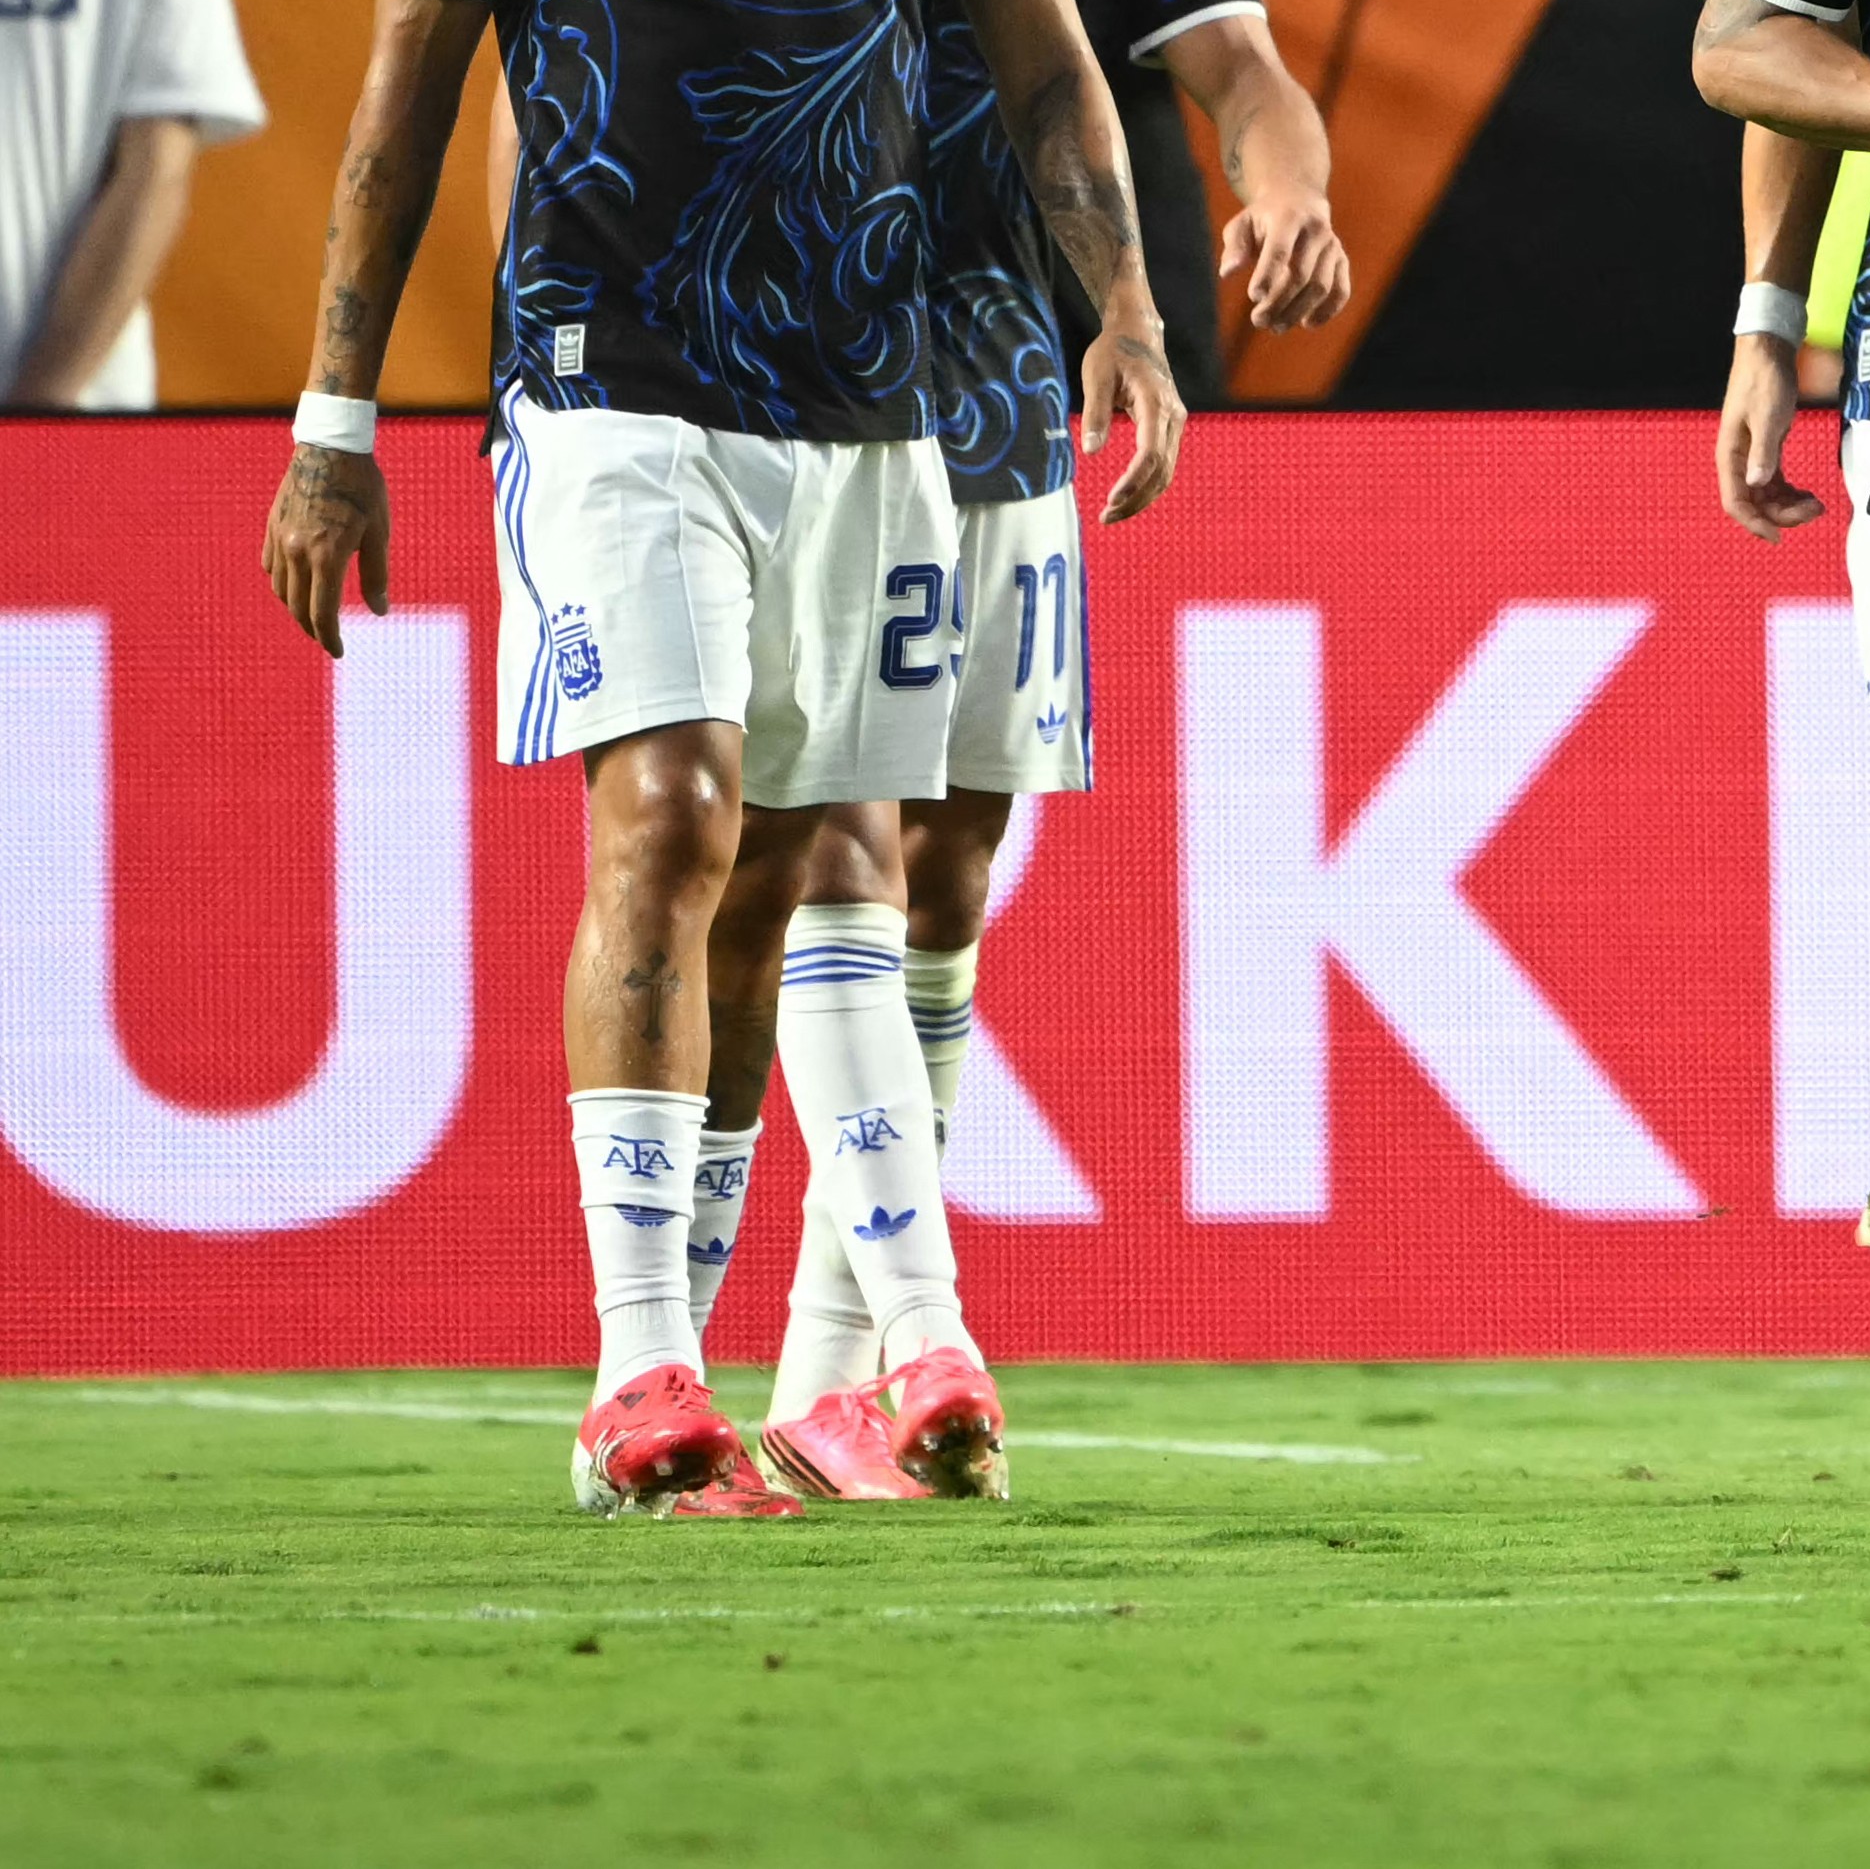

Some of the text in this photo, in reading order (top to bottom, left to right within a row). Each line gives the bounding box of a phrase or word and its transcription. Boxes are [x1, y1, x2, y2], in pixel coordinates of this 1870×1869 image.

[879, 559, 964, 691] 2
[1015, 553, 1066, 692] 11
[562, 642, 589, 678] AFA
[836, 1107, 902, 1156] AFA
[603, 1134, 674, 1178] AFA
[694, 1157, 748, 1199] AFA
